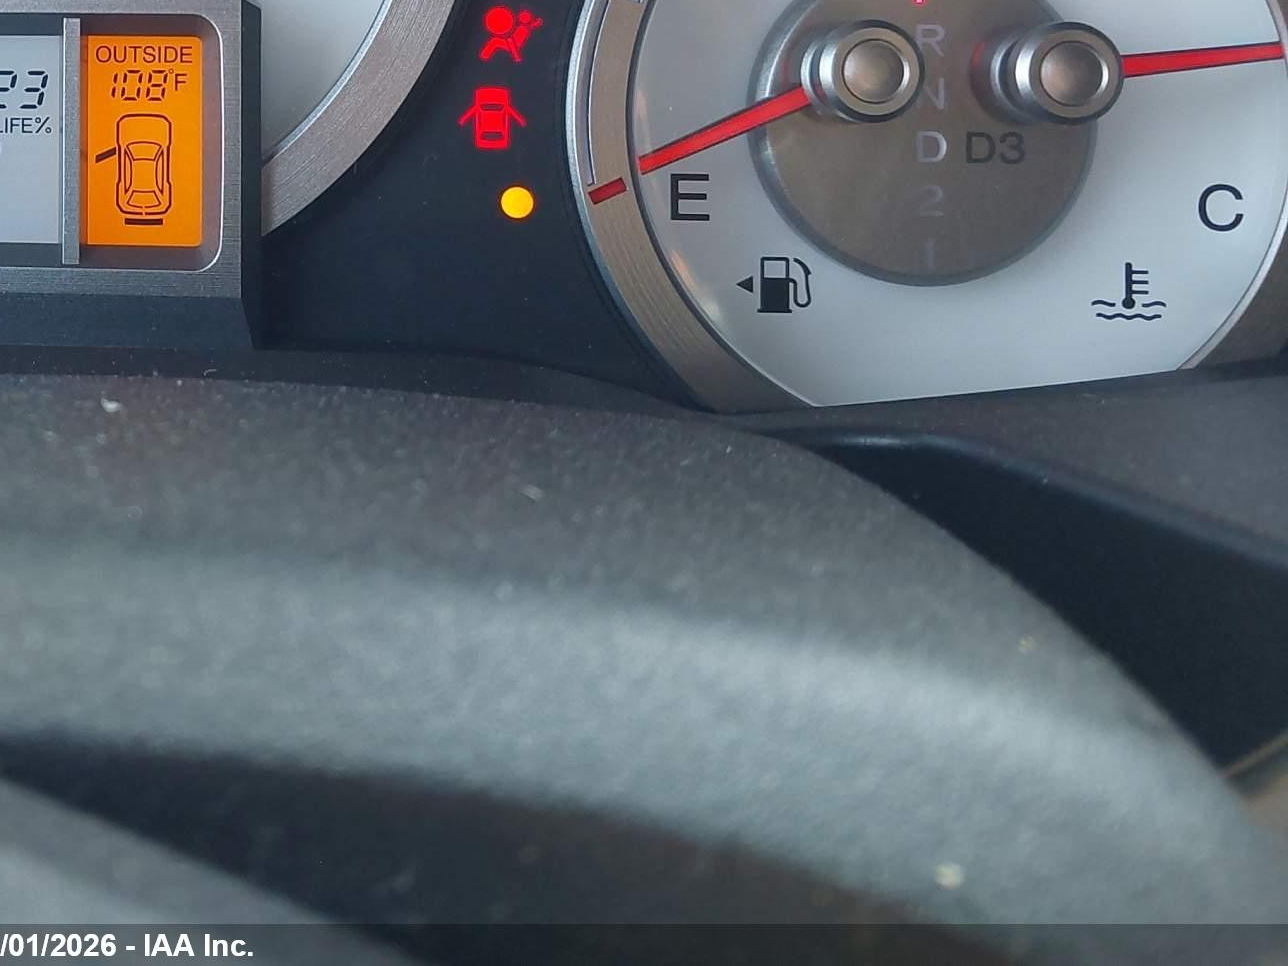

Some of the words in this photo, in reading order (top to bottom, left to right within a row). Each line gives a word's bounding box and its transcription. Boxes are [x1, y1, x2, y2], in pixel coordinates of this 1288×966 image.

[95, 45, 193, 64] OUTSIDE
[915, 24, 944, 56] R
[916, 77, 945, 110] N
[917, 130, 948, 163] D
[965, 131, 1026, 165] D3
[671, 175, 710, 221] E
[1198, 184, 1245, 232] C
